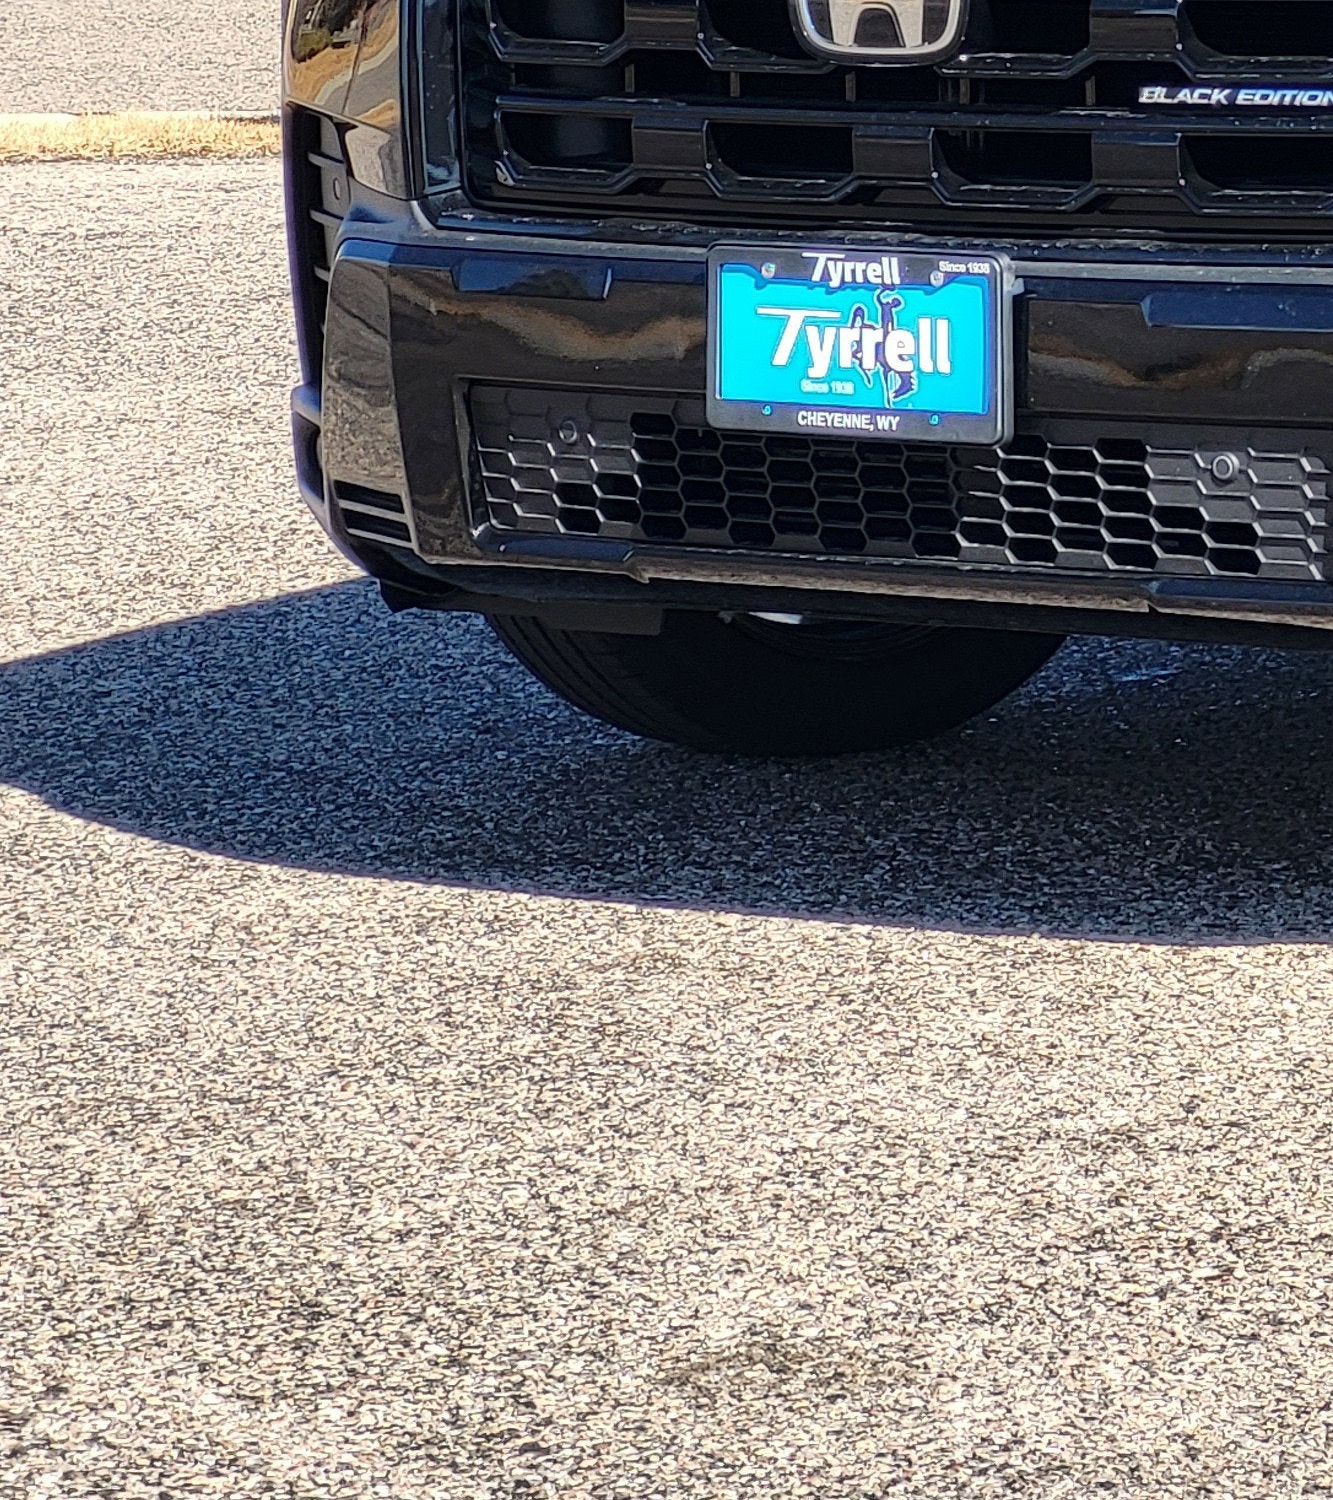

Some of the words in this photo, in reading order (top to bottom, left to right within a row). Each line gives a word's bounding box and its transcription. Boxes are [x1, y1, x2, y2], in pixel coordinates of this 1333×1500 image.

[1137, 86, 1230, 105] BLACK
[801, 252, 900, 288] Tyrrell
[755, 304, 953, 379] Tyrrell
[797, 410, 875, 432] CHEYENNE,
[876, 414, 900, 431] WY
